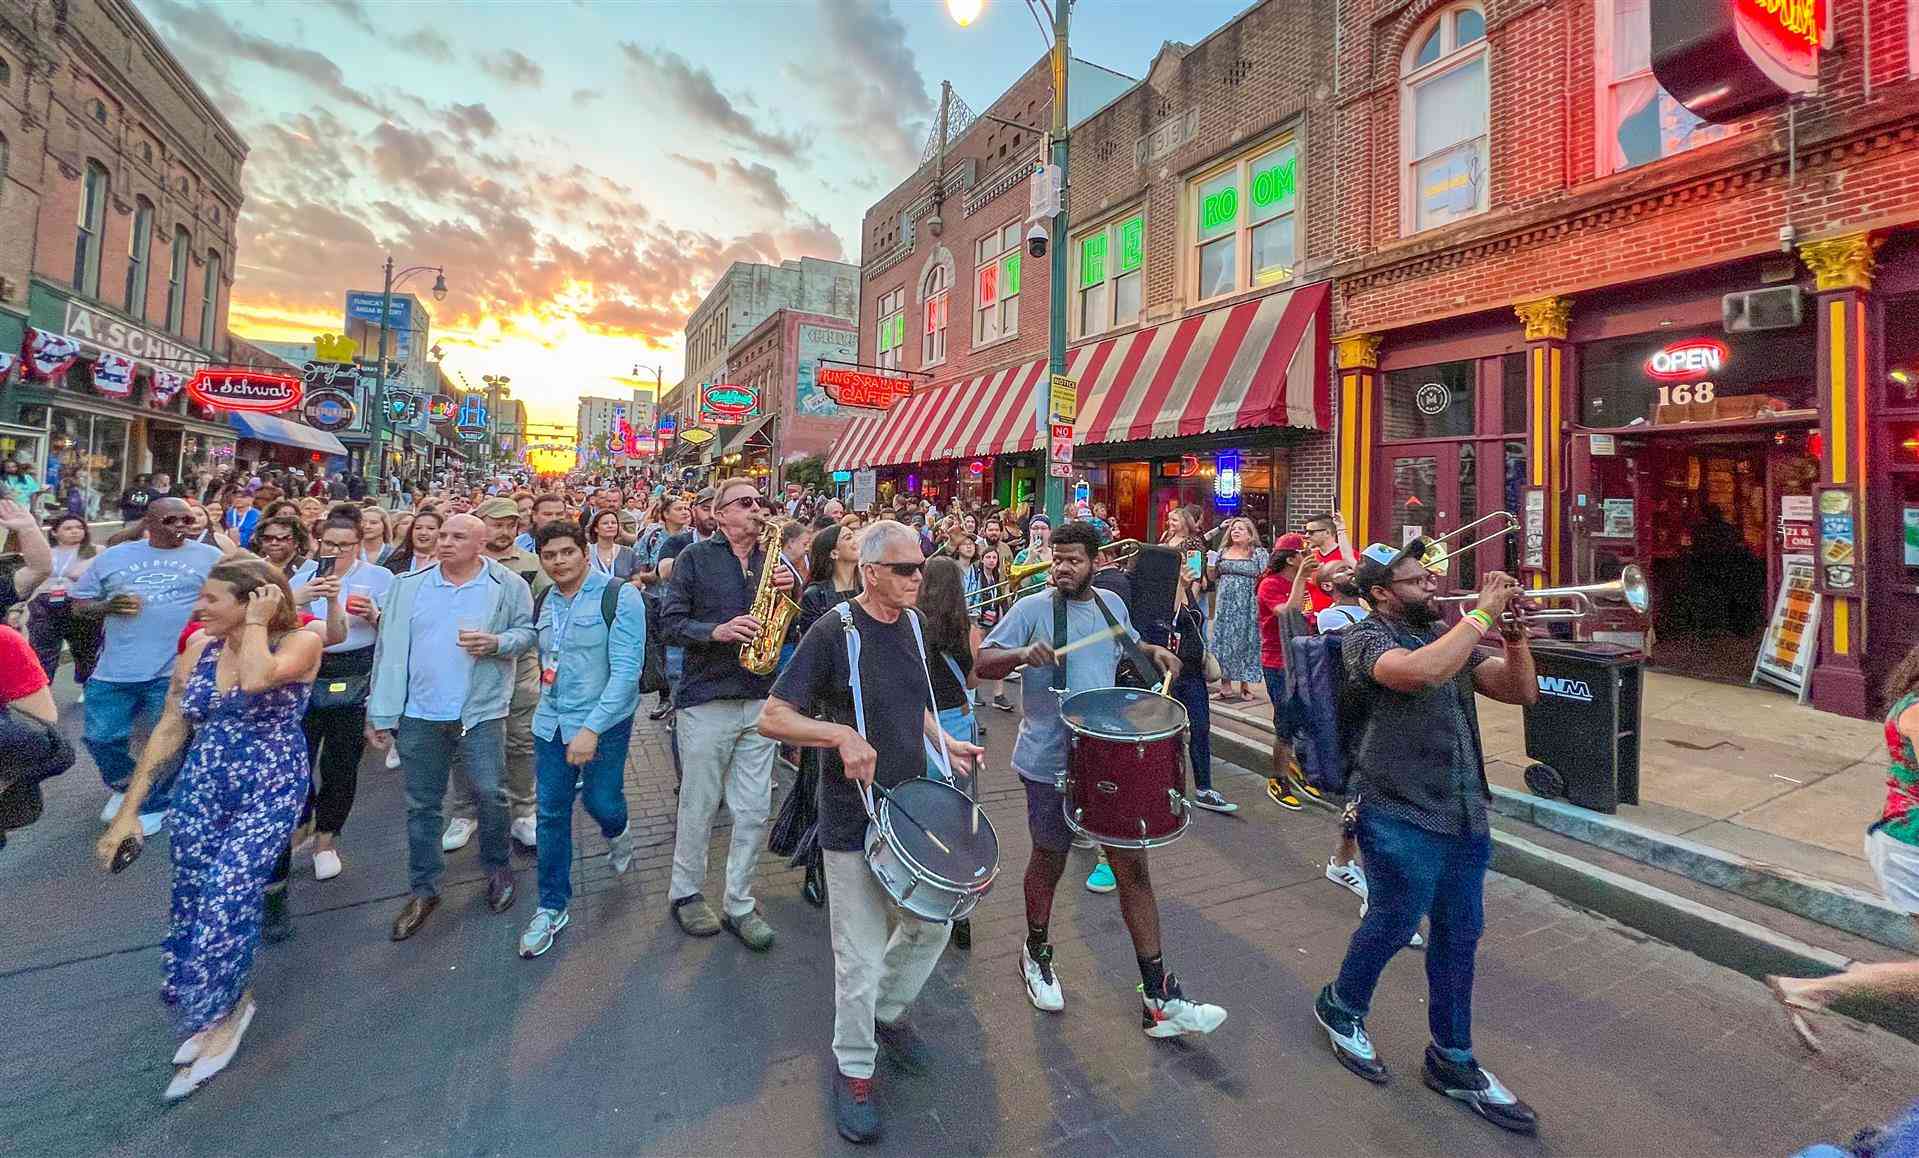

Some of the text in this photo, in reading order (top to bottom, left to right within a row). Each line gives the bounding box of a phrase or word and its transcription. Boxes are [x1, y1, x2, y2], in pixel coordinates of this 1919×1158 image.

[1204, 159, 1296, 228] ROOM
[1653, 347, 1721, 373] OPEN
[220, 376, 295, 398] Schwab
[841, 387, 892, 405] CAFE
[1656, 381, 1715, 406] 168
[1055, 427, 1069, 436] NO
[1786, 528, 1798, 537] 21
[1791, 537, 1814, 546] ONL
[1537, 675, 1595, 698] WM
